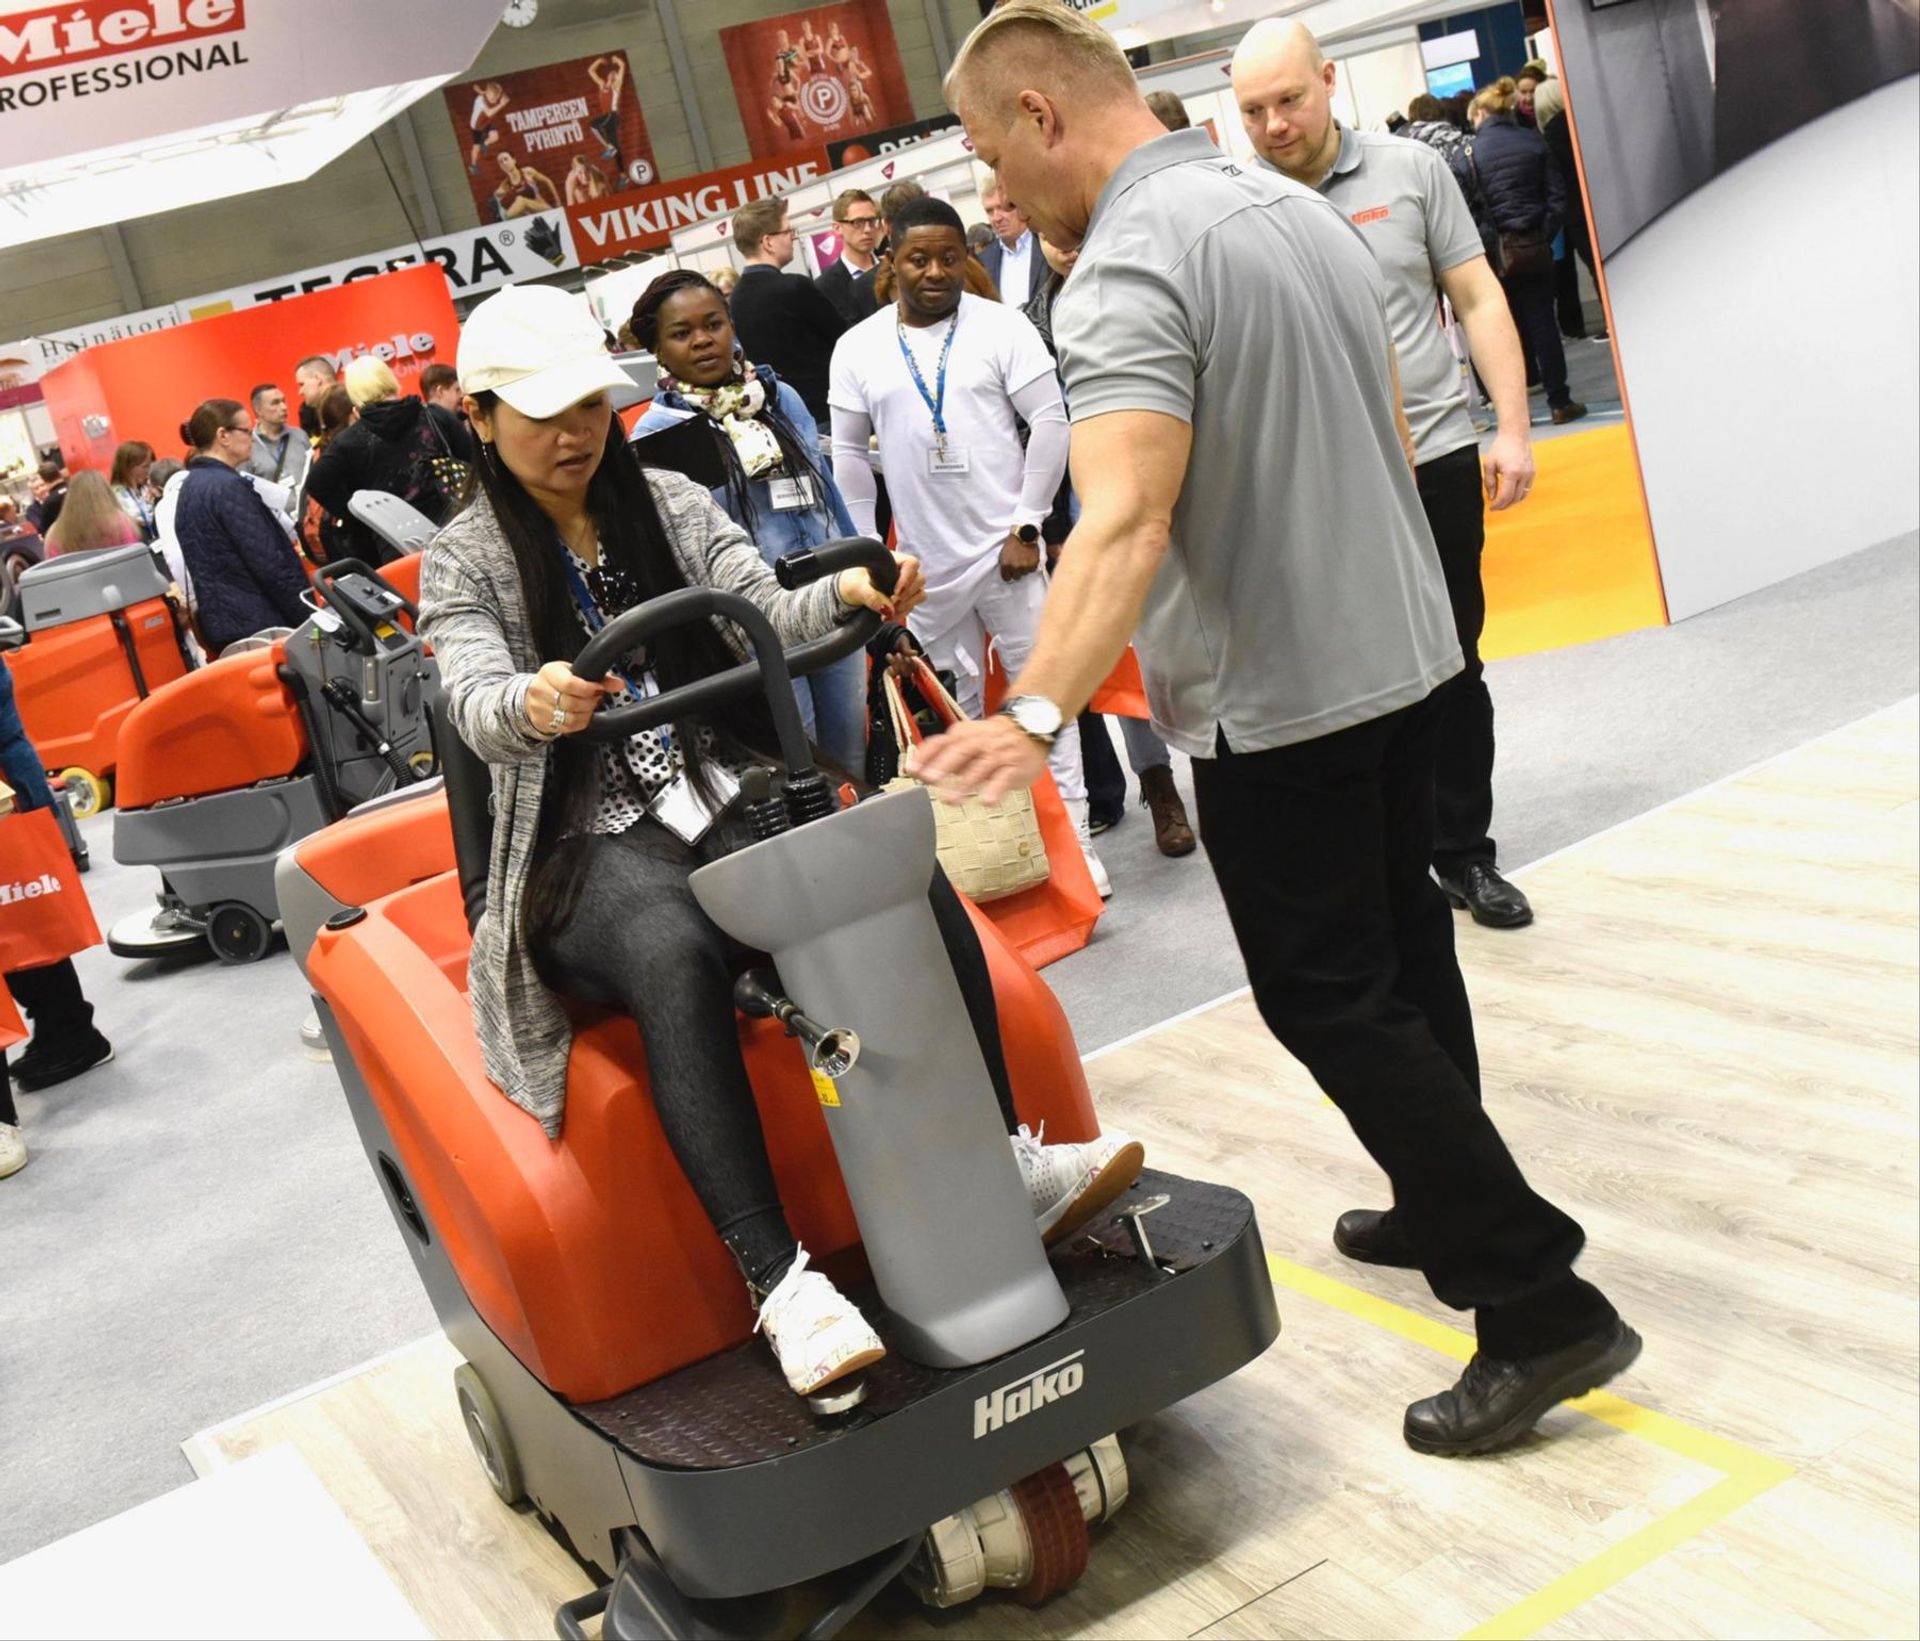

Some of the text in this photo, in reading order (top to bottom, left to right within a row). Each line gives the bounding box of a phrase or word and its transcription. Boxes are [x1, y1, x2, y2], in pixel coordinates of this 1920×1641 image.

[0, 0, 236, 64] Miele
[505, 97, 589, 133] TAMPEREEN
[523, 119, 584, 153] PYRINTÖ
[577, 184, 728, 246] VIKING
[973, 1348, 1085, 1440] Hako
